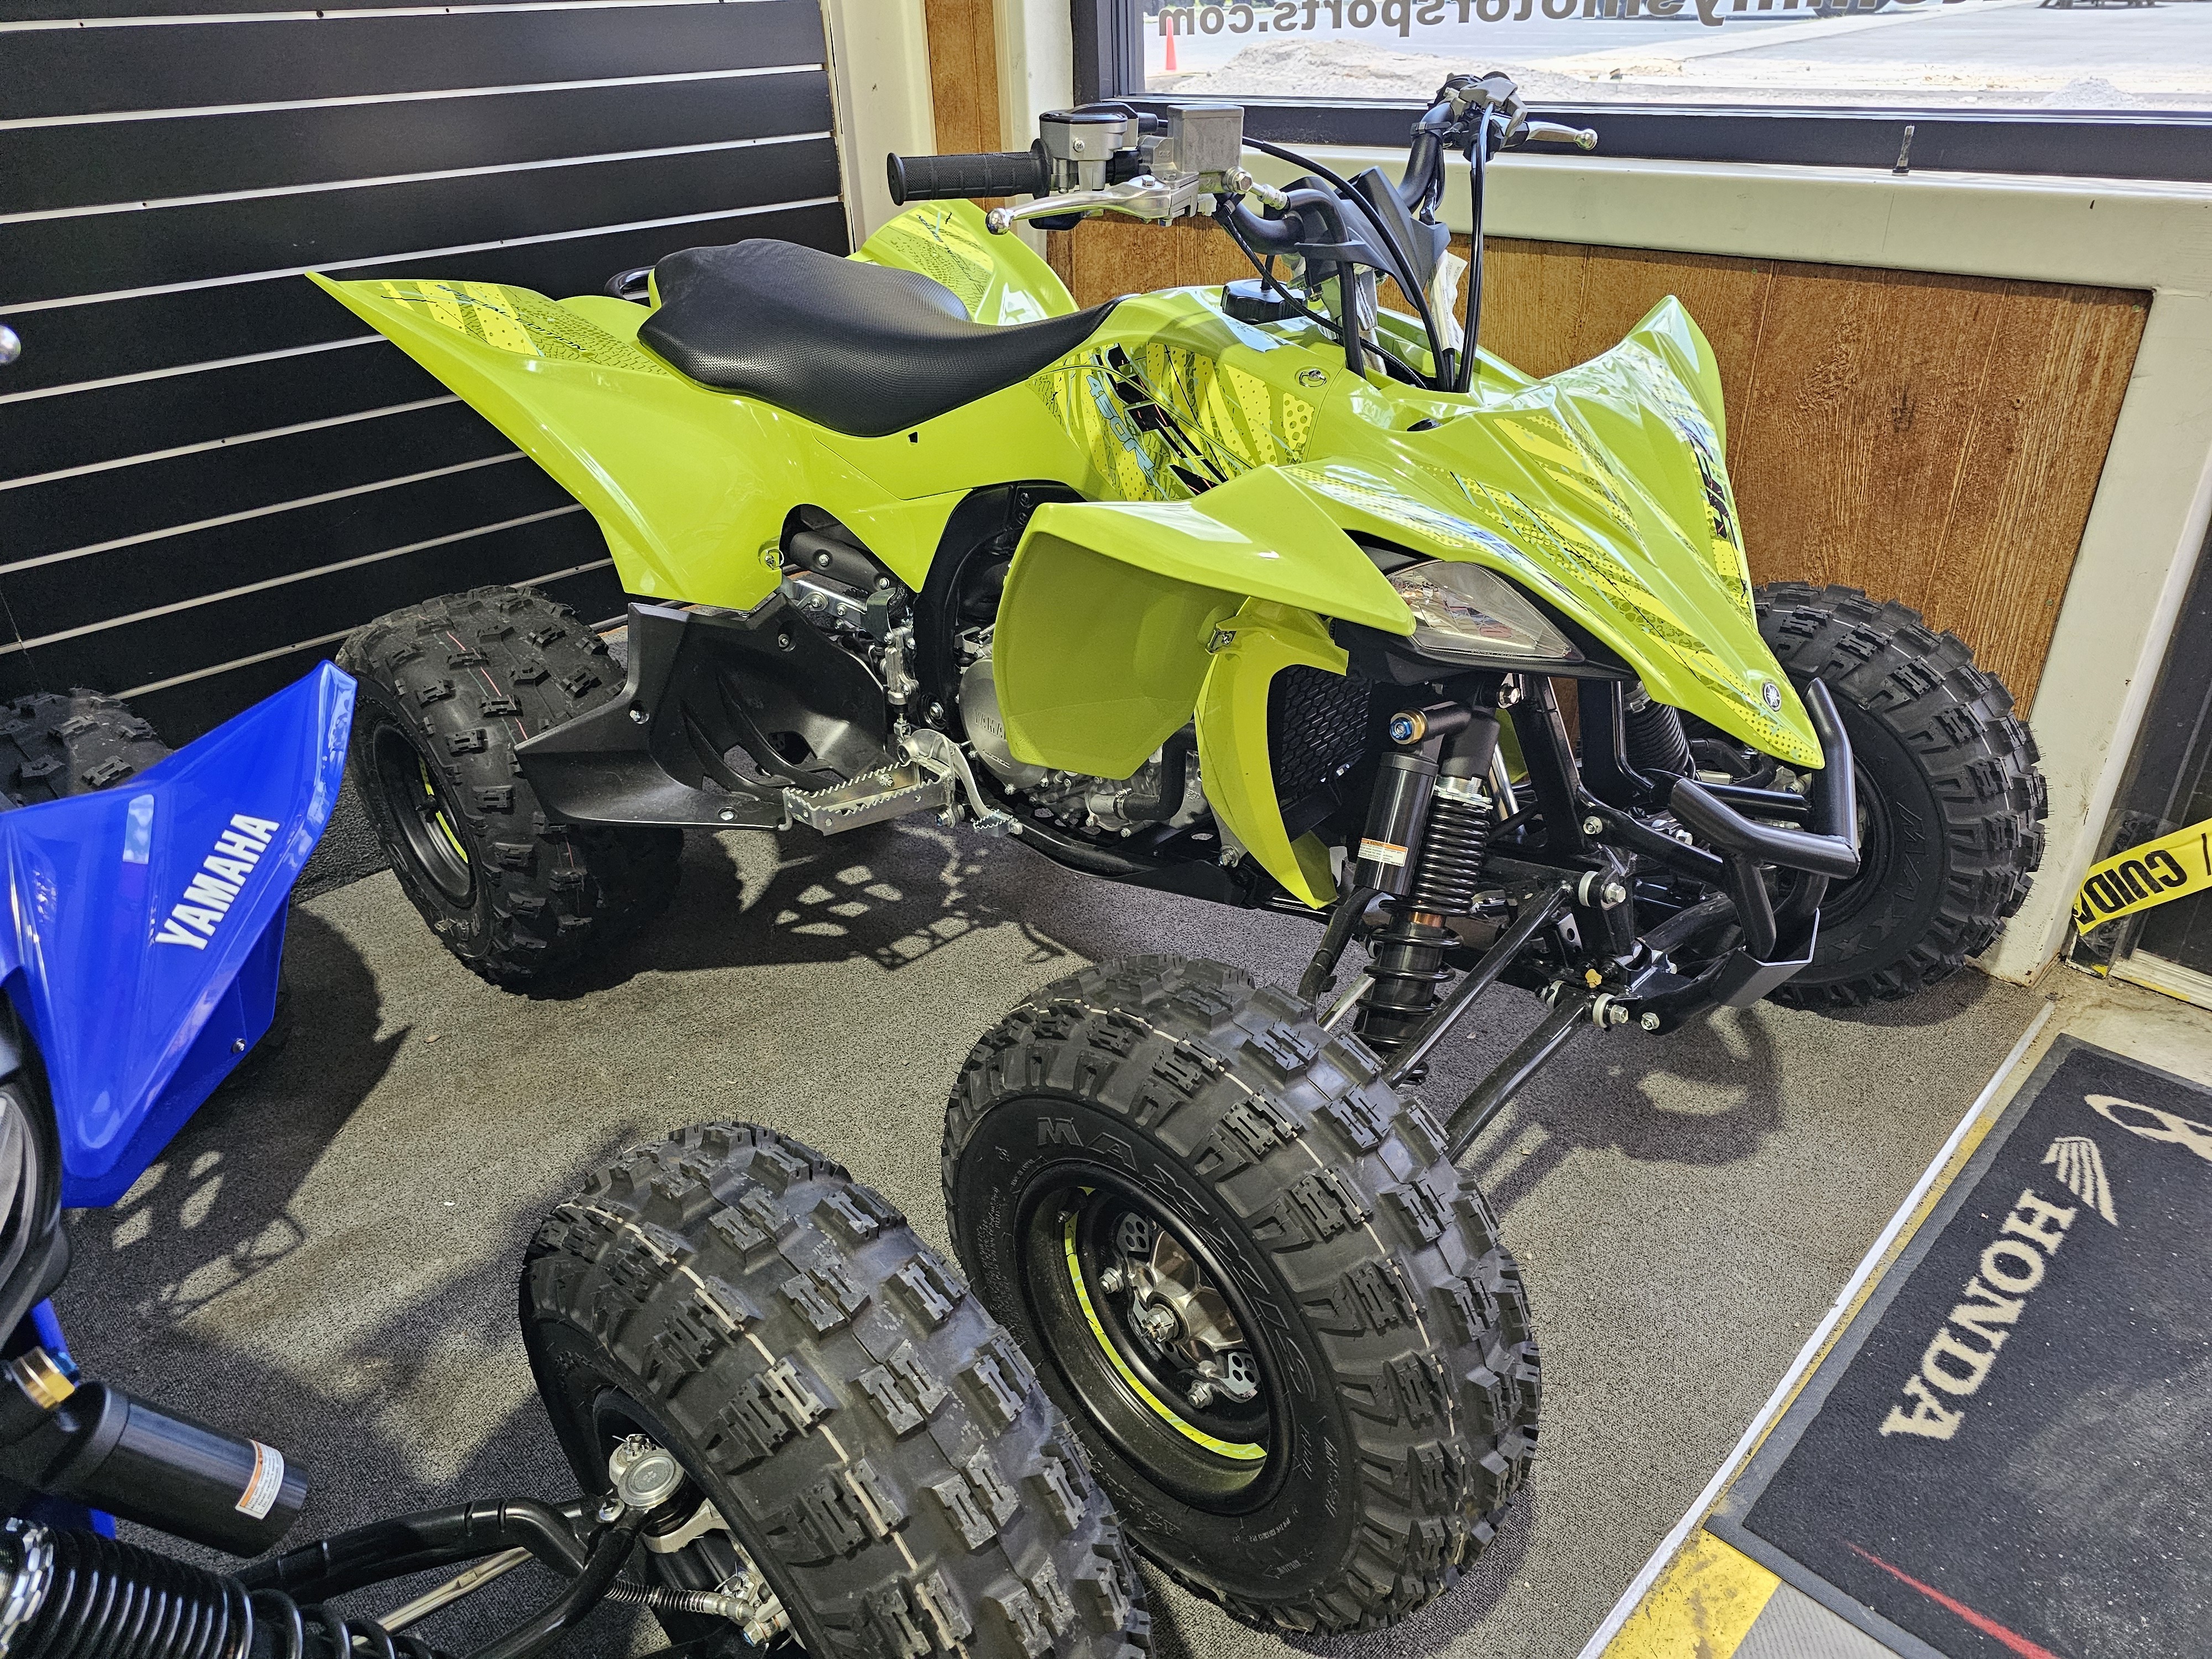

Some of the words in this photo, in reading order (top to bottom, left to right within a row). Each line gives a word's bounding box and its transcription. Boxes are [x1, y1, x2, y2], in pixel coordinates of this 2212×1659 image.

[435, 284, 510, 318] SPECIAL
[515, 317, 588, 352] EDITION
[1086, 374, 1155, 481] 450R
[155, 813, 280, 950] YAMAHA
[1037, 1117, 1316, 1402] MAXXIS
[1879, 1187, 2079, 1441] HONDA
